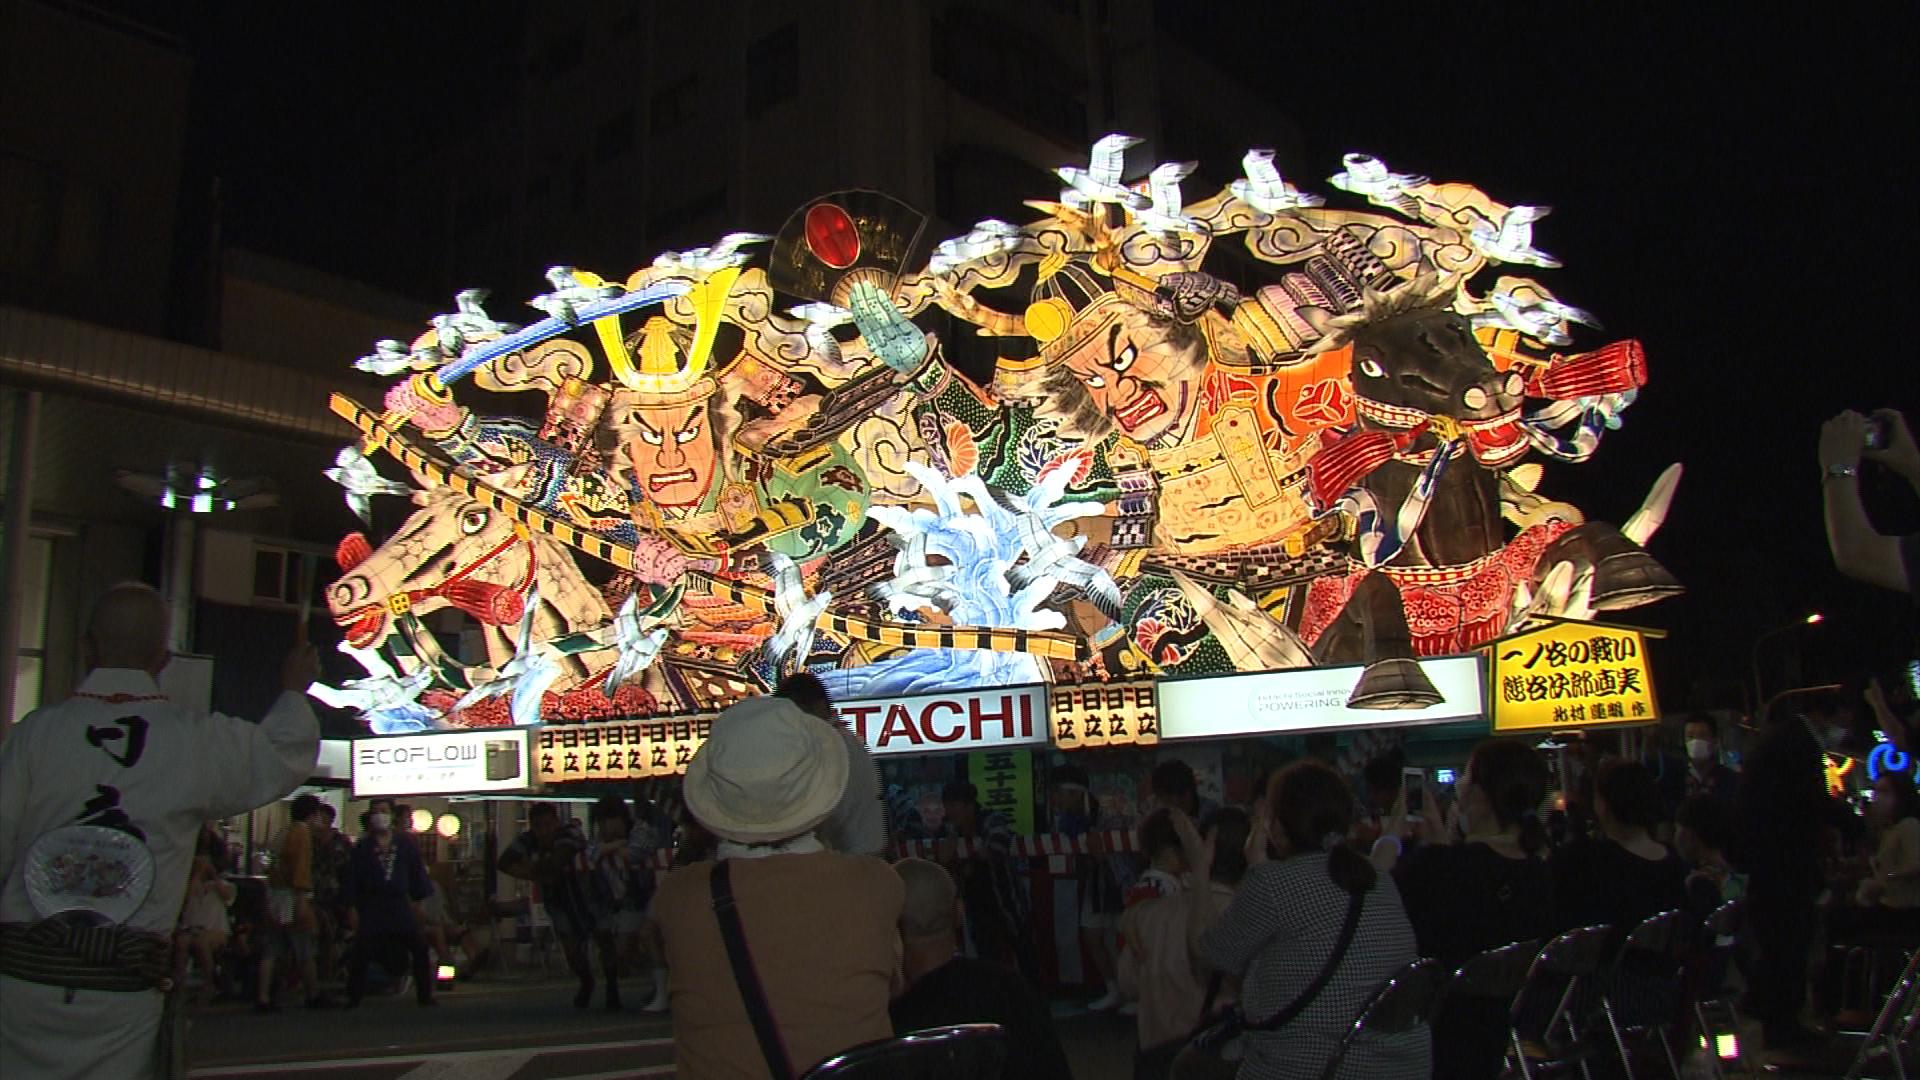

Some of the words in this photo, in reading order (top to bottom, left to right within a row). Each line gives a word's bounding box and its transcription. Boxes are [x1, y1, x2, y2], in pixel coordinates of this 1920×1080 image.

[1501, 636, 1636, 669] 一ノ谷の戦い
[832, 694, 1032, 747] TACHI
[1055, 691, 1076, 740] 日立
[1083, 689, 1104, 737] 日立
[1106, 688, 1128, 736] 日立
[1136, 687, 1157, 736] 日立
[1553, 704, 1585, 722] 北村
[360, 744, 478, 765] ECOFLOW
[541, 731, 554, 773] 日立
[563, 730, 579, 772] 日立
[585, 728, 601, 771] 日立
[607, 726, 624, 770] 日立
[626, 725, 641, 770] 日立
[651, 722, 667, 767] 日立
[674, 721, 691, 765] 日立
